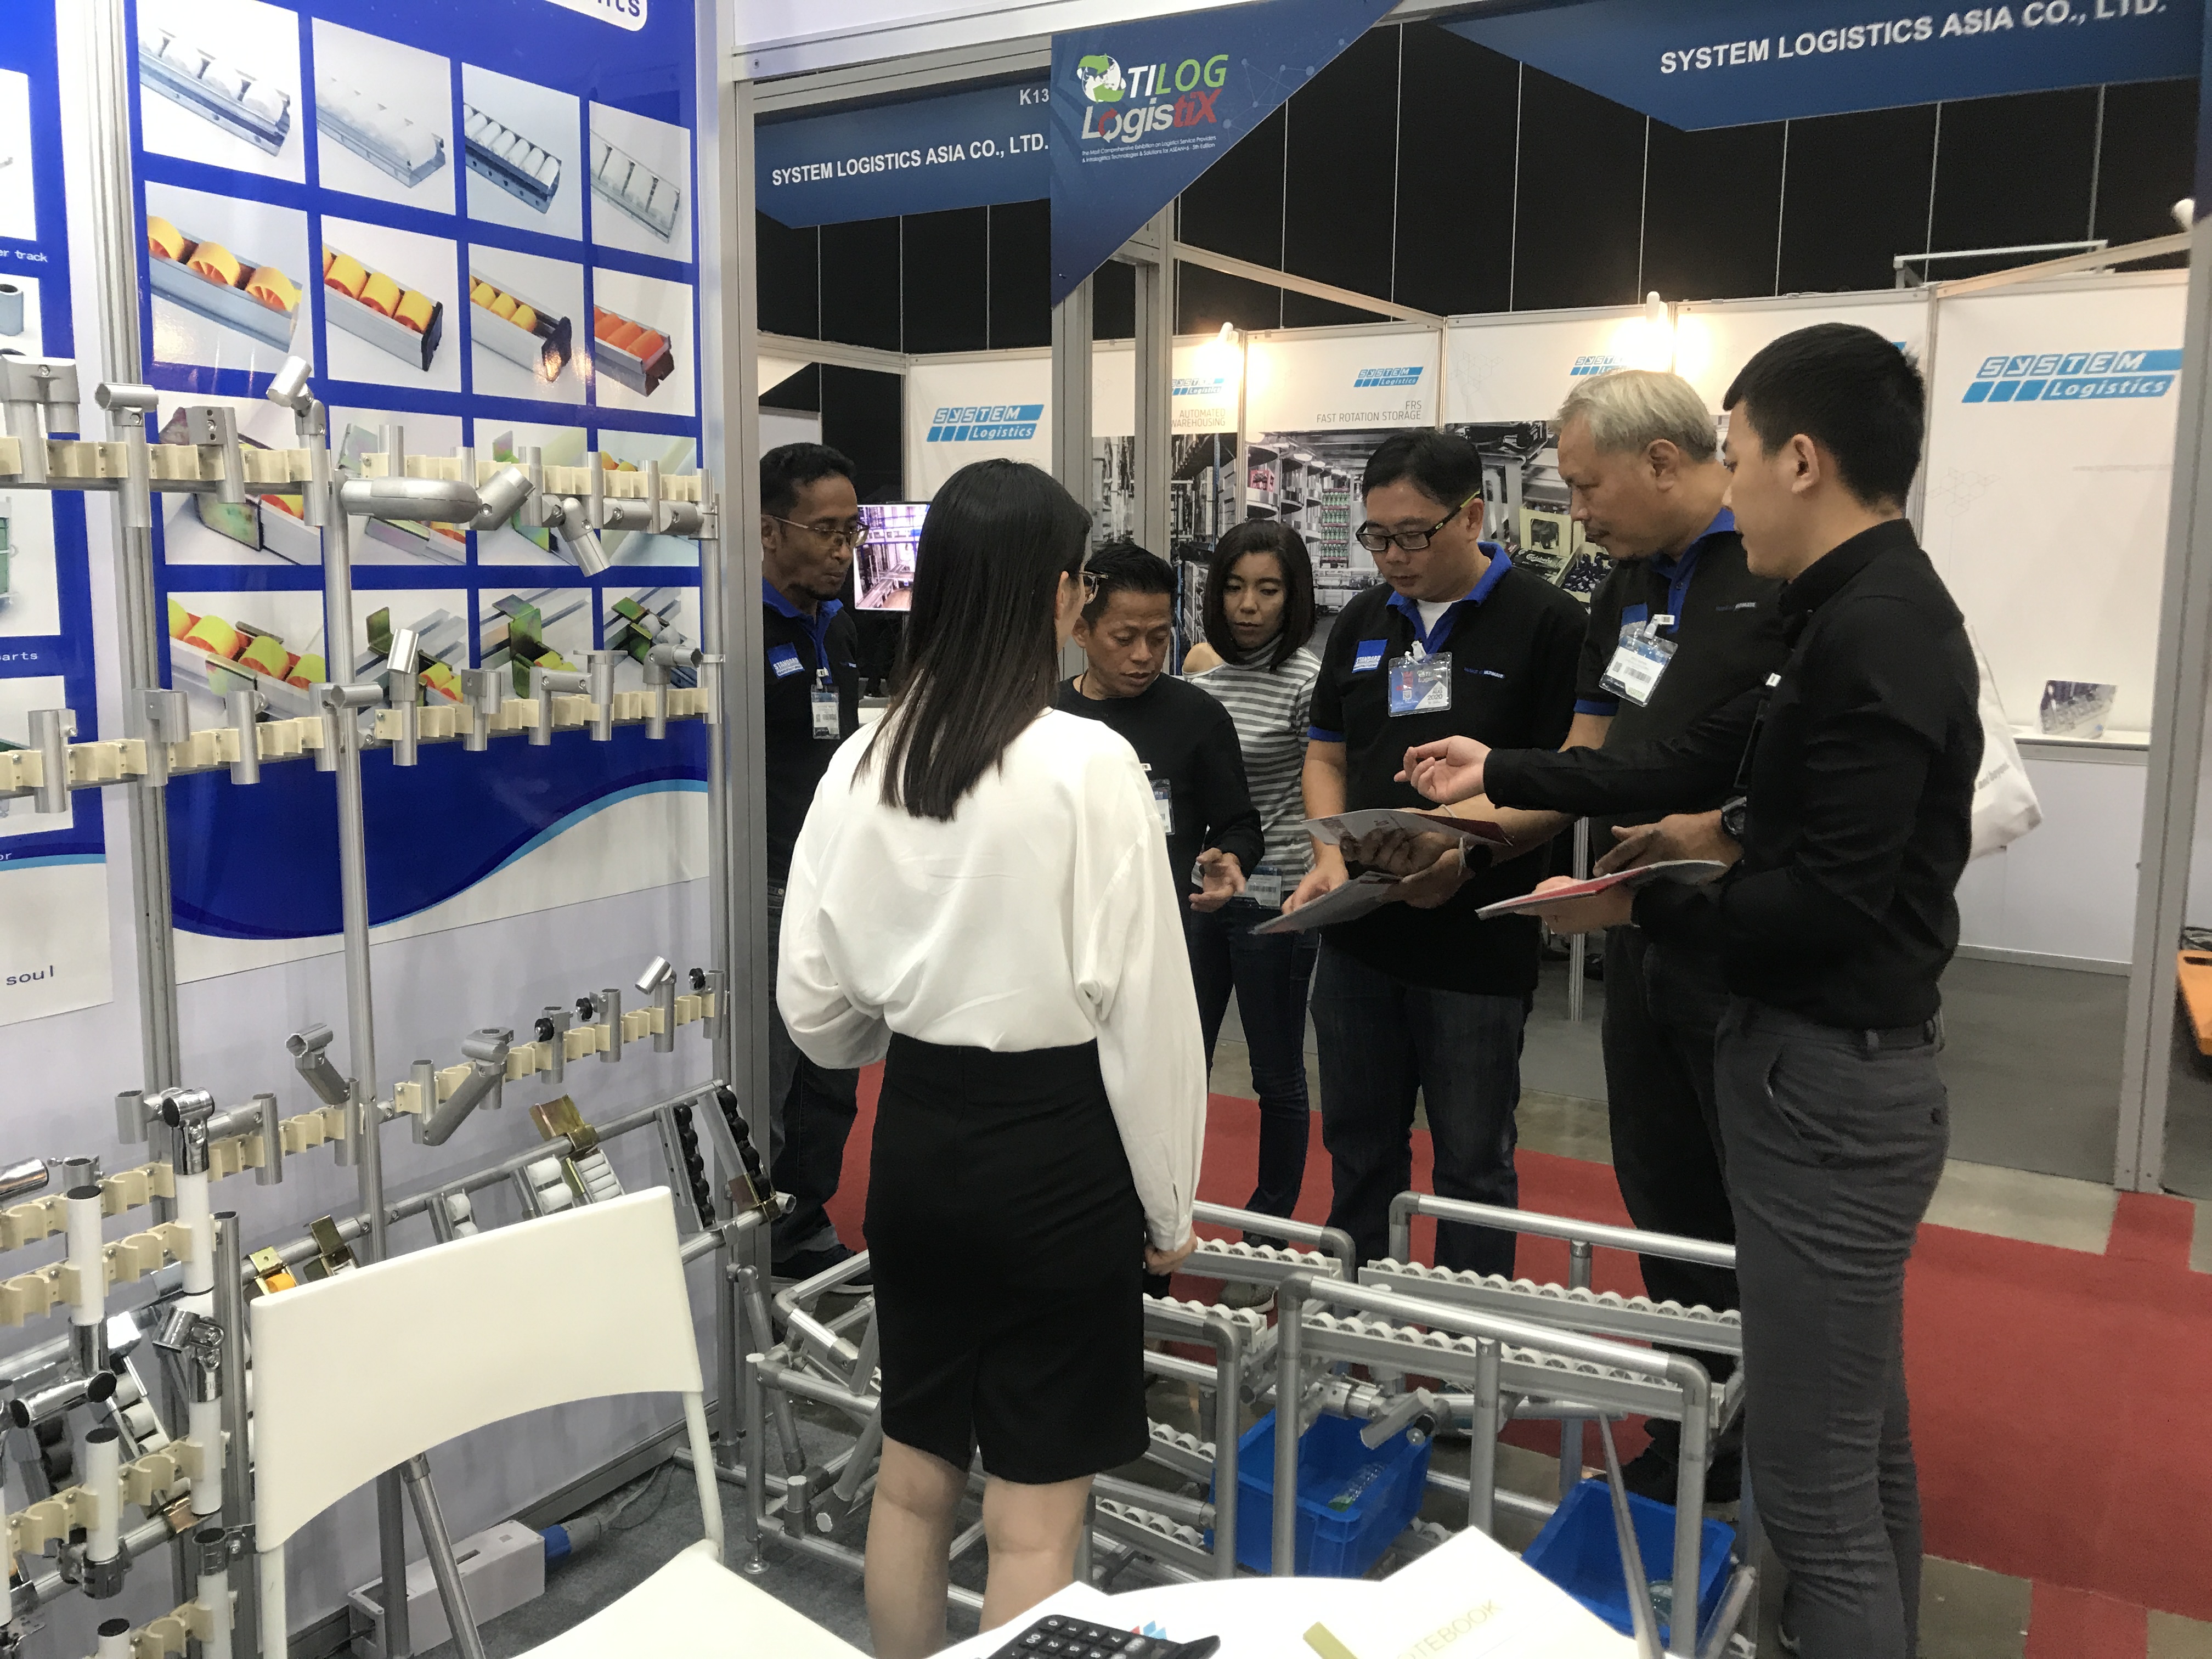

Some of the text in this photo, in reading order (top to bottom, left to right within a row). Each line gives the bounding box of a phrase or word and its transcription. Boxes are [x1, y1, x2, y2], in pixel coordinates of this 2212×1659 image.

[1661, 40, 1769, 74] SYSTEM
[1778, 16, 1932, 59] LOGISTICS
[1939, 6, 2014, 38] ASIA
[2022, 0, 2086, 27] CO.,
[1128, 54, 1228, 98] TILOG
[1020, 88, 1049, 105] K13
[772, 133, 1048, 185] SYSTEM LOGISTICS ASIA CO., LTD.
[14, 250, 48, 262] track
[1979, 352, 2147, 376] SYSTEM
[1359, 368, 1409, 377] SYSTEM
[1381, 377, 1416, 385] Logistics
[2050, 378, 2166, 398] Logistics
[1406, 400, 1422, 410] FRS
[934, 406, 1021, 422] SYSTEM
[1180, 408, 1226, 418] AUTOMATED
[1317, 410, 1421, 423] FAST ROTATION STORAGE
[973, 426, 1032, 439] Logistics
[0, 652, 38, 661] arts
[6, 964, 54, 985] soul
